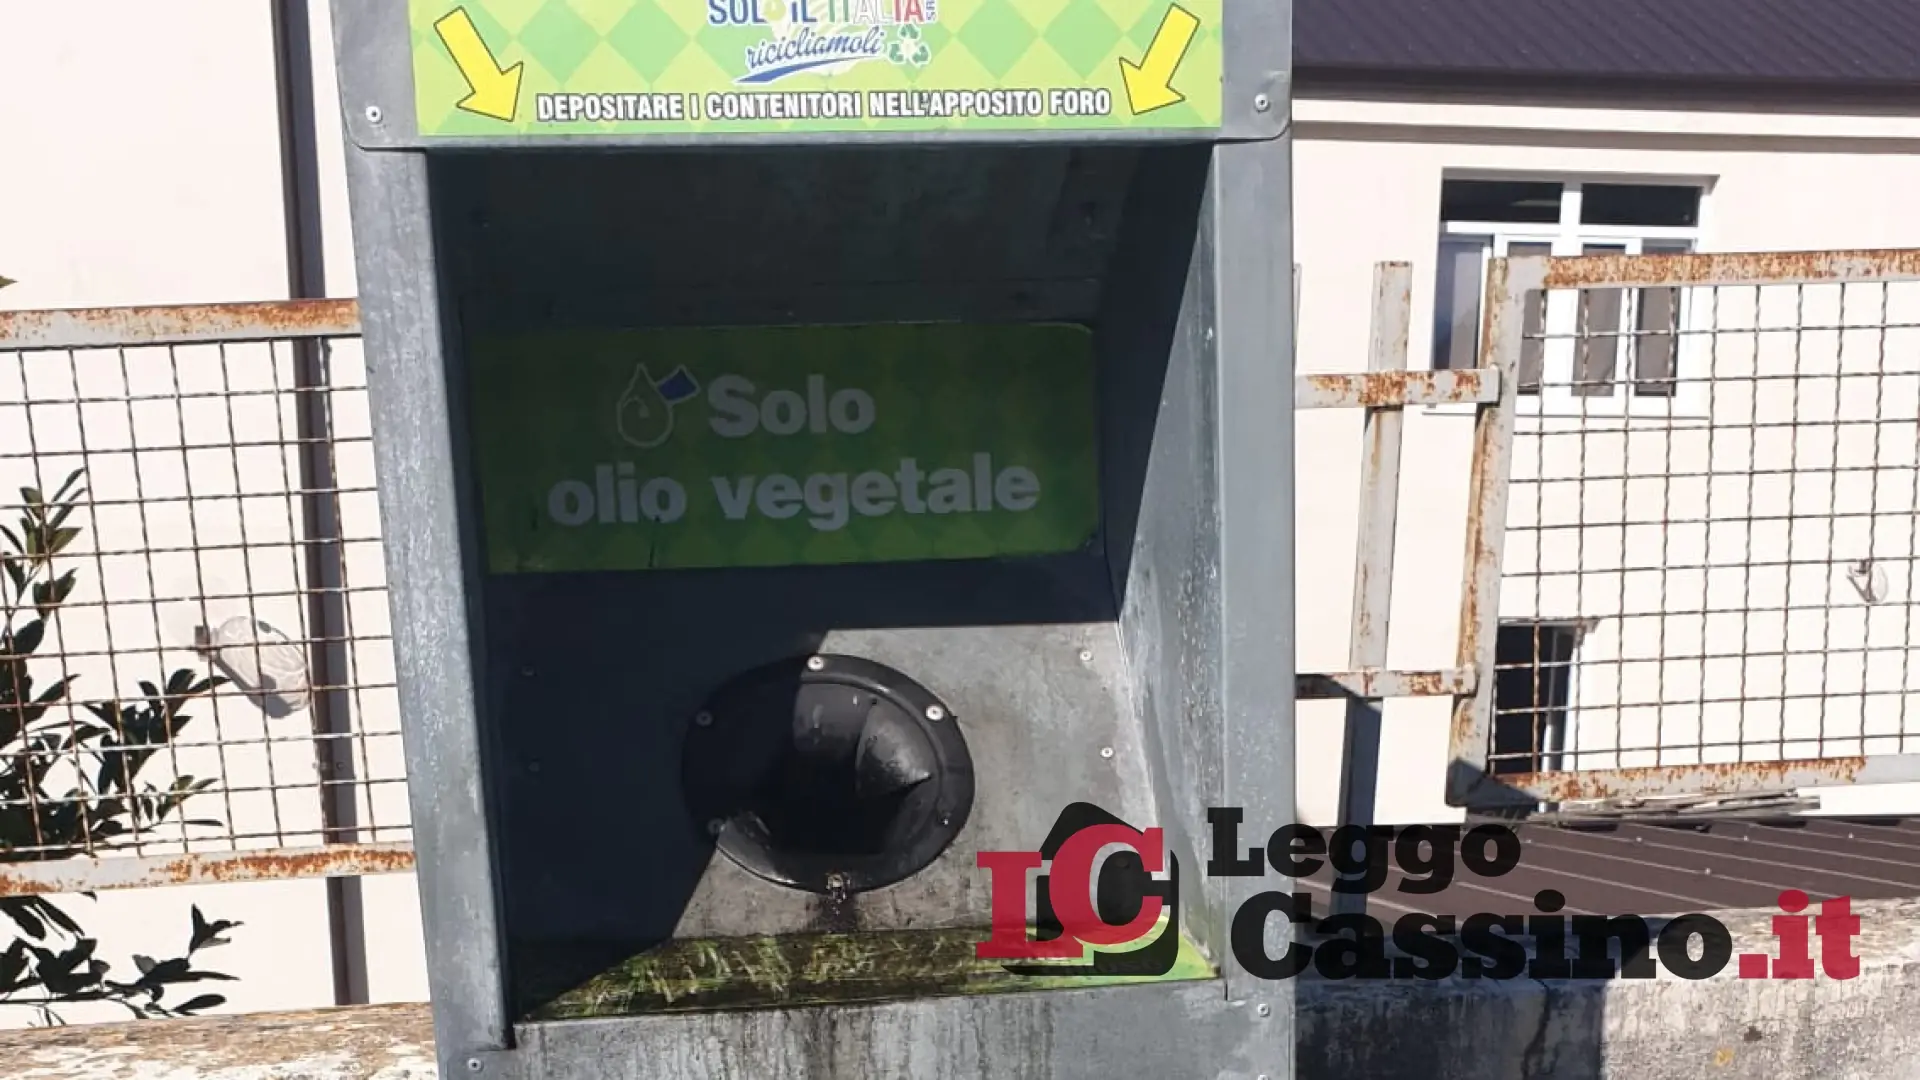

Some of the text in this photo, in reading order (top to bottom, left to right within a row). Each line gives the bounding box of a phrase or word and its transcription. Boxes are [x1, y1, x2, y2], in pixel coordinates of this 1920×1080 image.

[747, 25, 885, 69] ricicliamoli
[537, 88, 1111, 121] DEPOSITARE I CONTENITORI NELL'APPOSITO FORO
[708, 374, 876, 438] Solo
[547, 452, 1041, 532] olio vegetale
